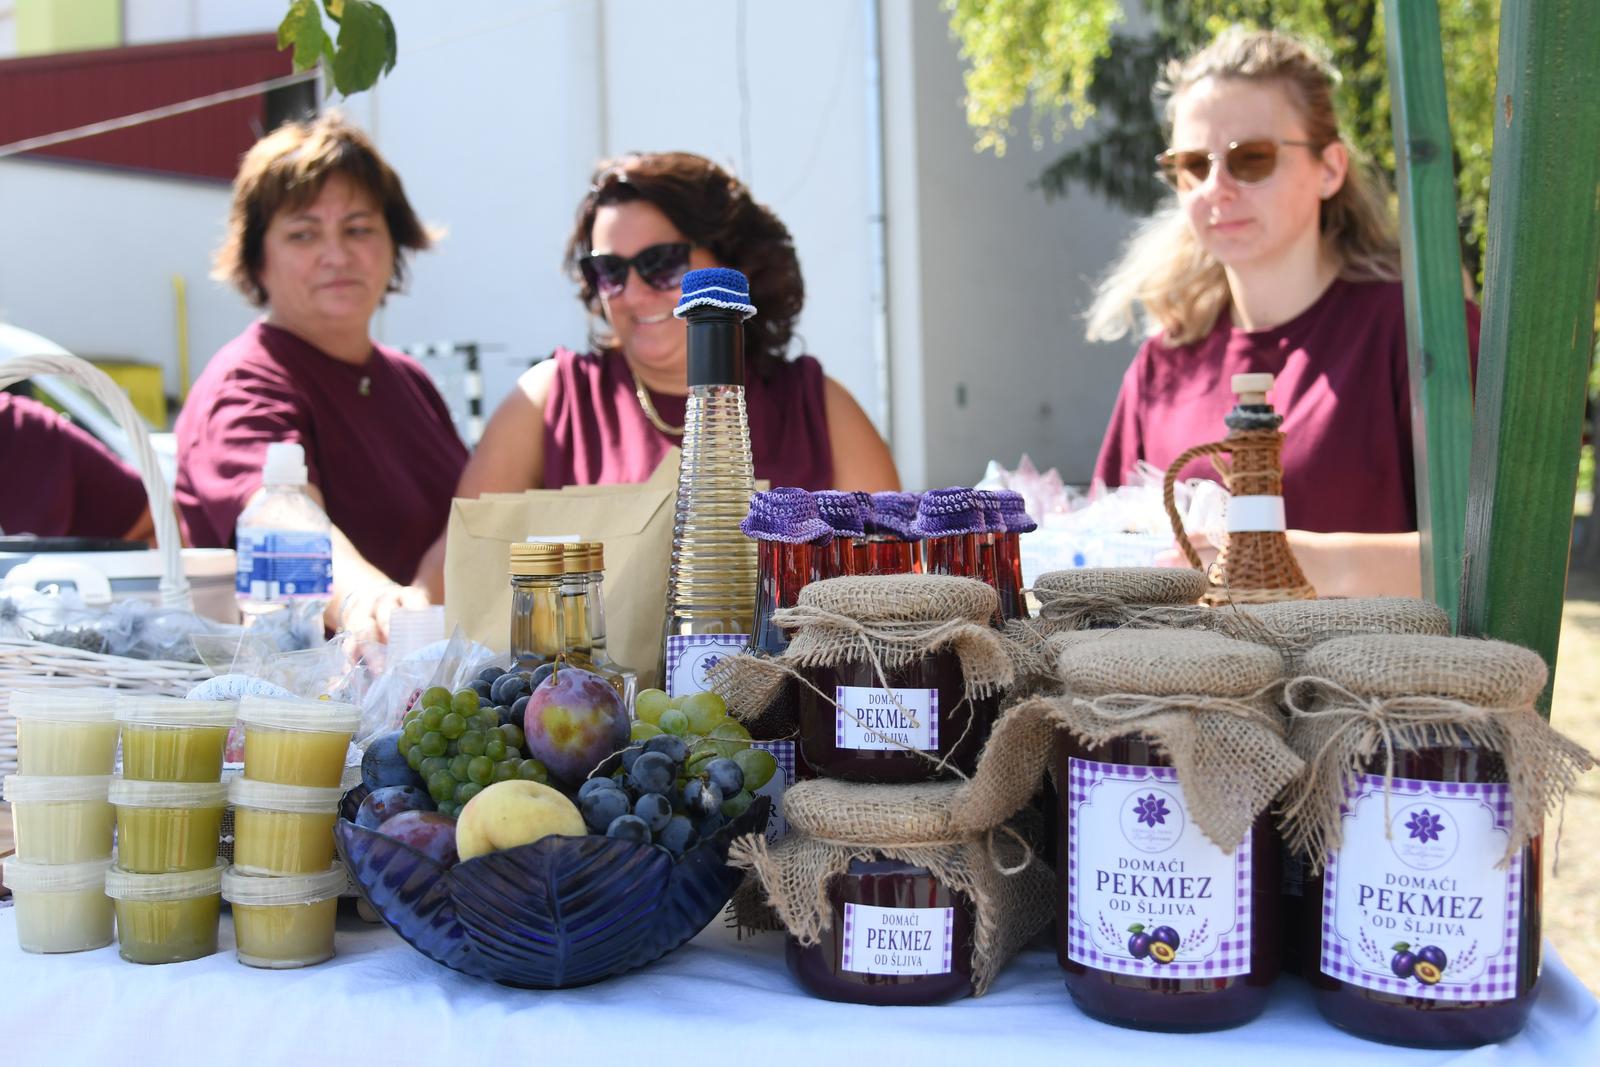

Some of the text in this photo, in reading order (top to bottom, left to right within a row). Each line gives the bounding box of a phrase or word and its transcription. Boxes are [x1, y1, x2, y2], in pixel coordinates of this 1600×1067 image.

[856, 708, 918, 729] PEKMEZ
[863, 732, 876, 743] OD
[1118, 857, 1185, 873] DOMAĆI
[1096, 869, 1213, 899] PEKMEZ
[1384, 872, 1457, 892] DOMAĆI
[1109, 898, 1196, 916] OD ŠLJIVA
[1357, 883, 1484, 920] PEKMEZ
[882, 912, 919, 926] DOMAĆI
[1372, 914, 1466, 937] OD ŠLJIVA
[867, 927, 932, 951] PEKMEZ
[874, 952, 922, 967] OD ŠLJIVA
